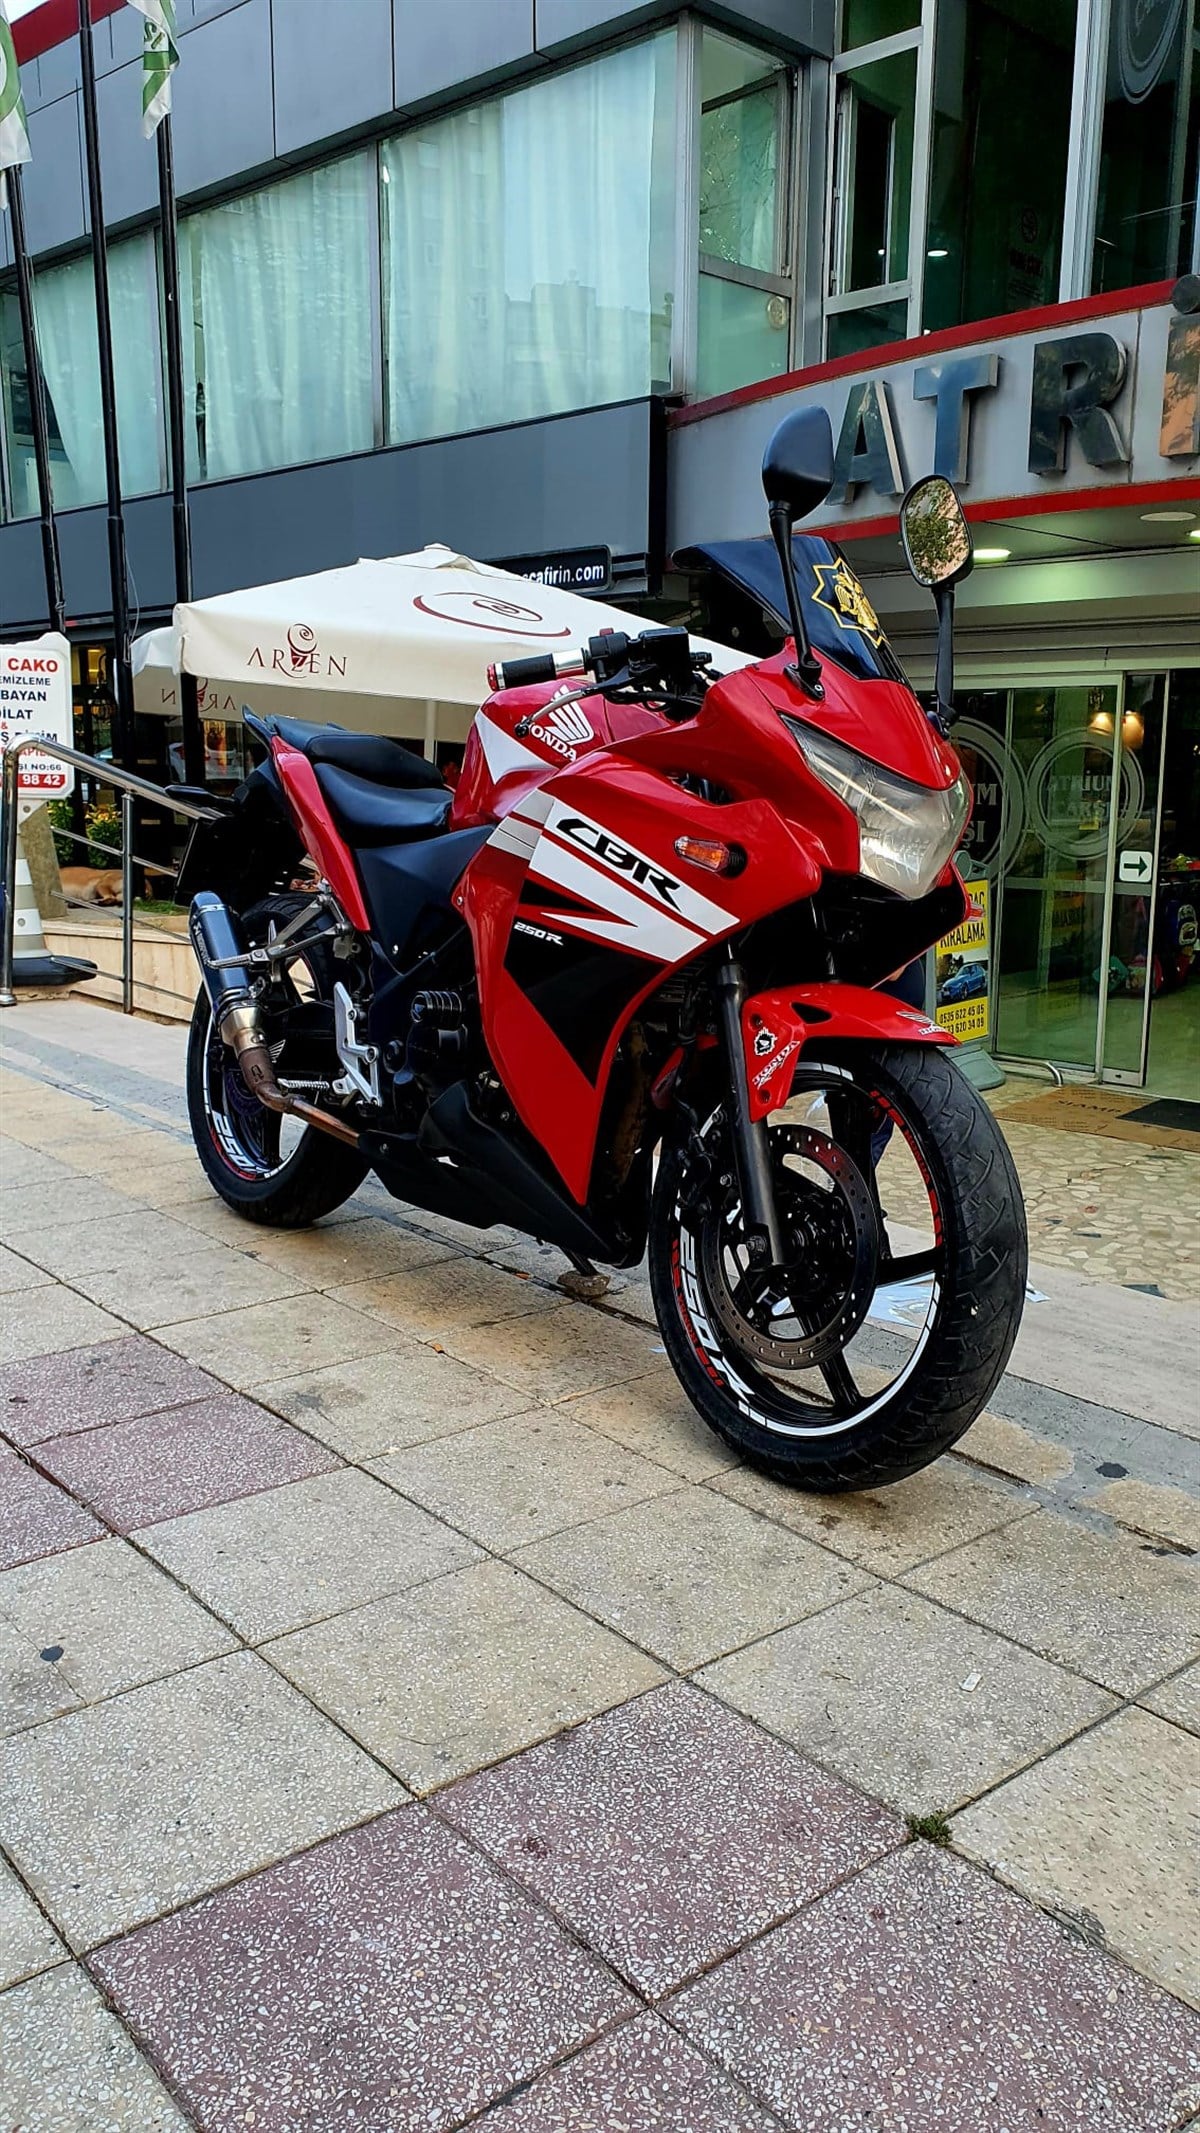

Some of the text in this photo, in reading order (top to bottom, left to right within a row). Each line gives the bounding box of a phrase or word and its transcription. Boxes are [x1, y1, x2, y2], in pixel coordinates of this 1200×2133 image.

[8, 658, 58, 672] CAKO
[1, 690, 47, 701] BAYAN
[521, 714, 577, 763] ONDA
[22, 775, 61, 786] 98 42
[556, 818, 682, 913] CBR
